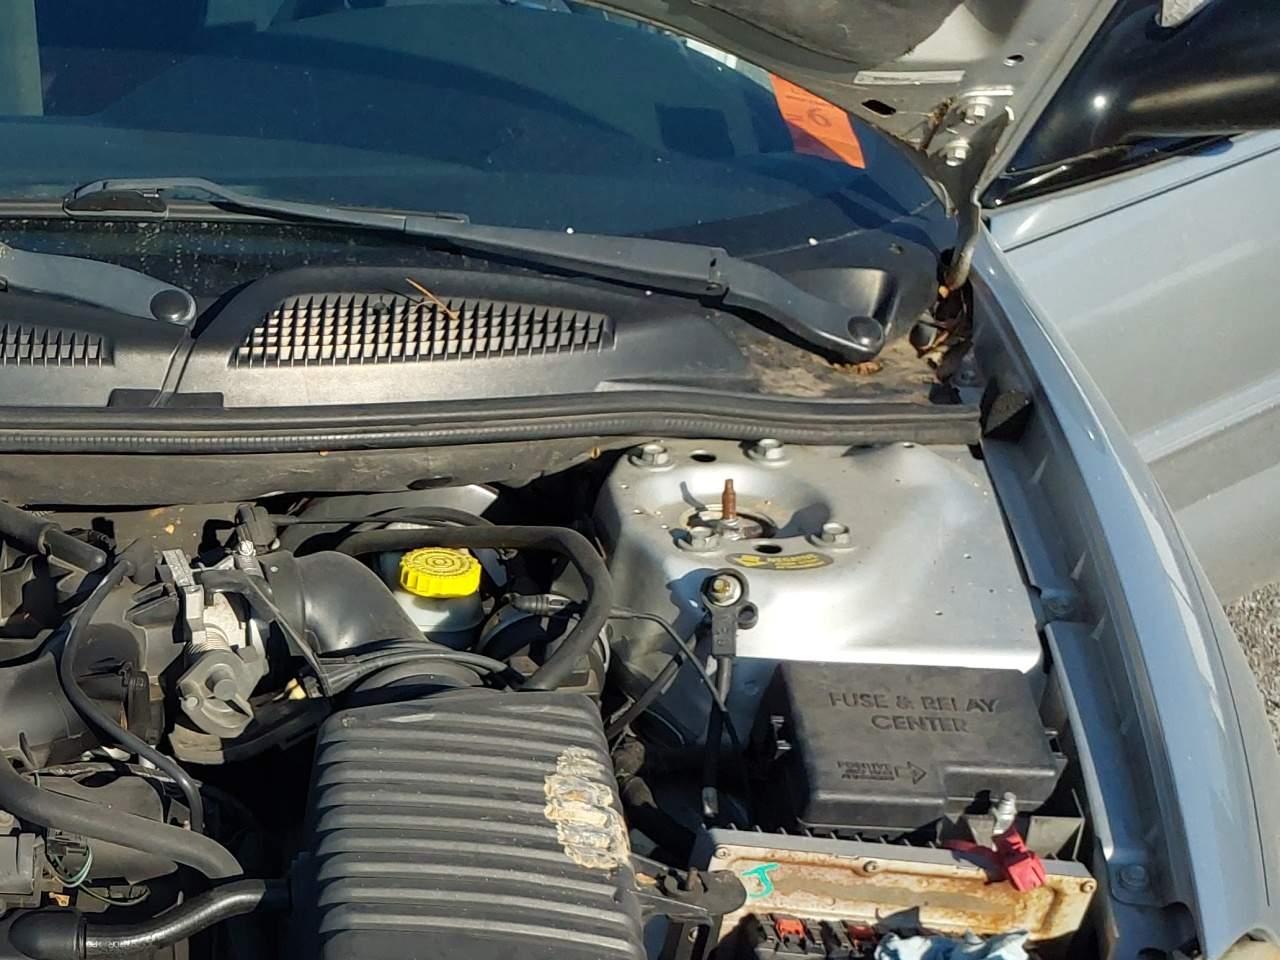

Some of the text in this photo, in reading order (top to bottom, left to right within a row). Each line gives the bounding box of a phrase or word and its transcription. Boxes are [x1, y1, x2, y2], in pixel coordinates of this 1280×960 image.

[829, 692, 1000, 713] FUSE & RELAY
[871, 715, 969, 733] CENTER
